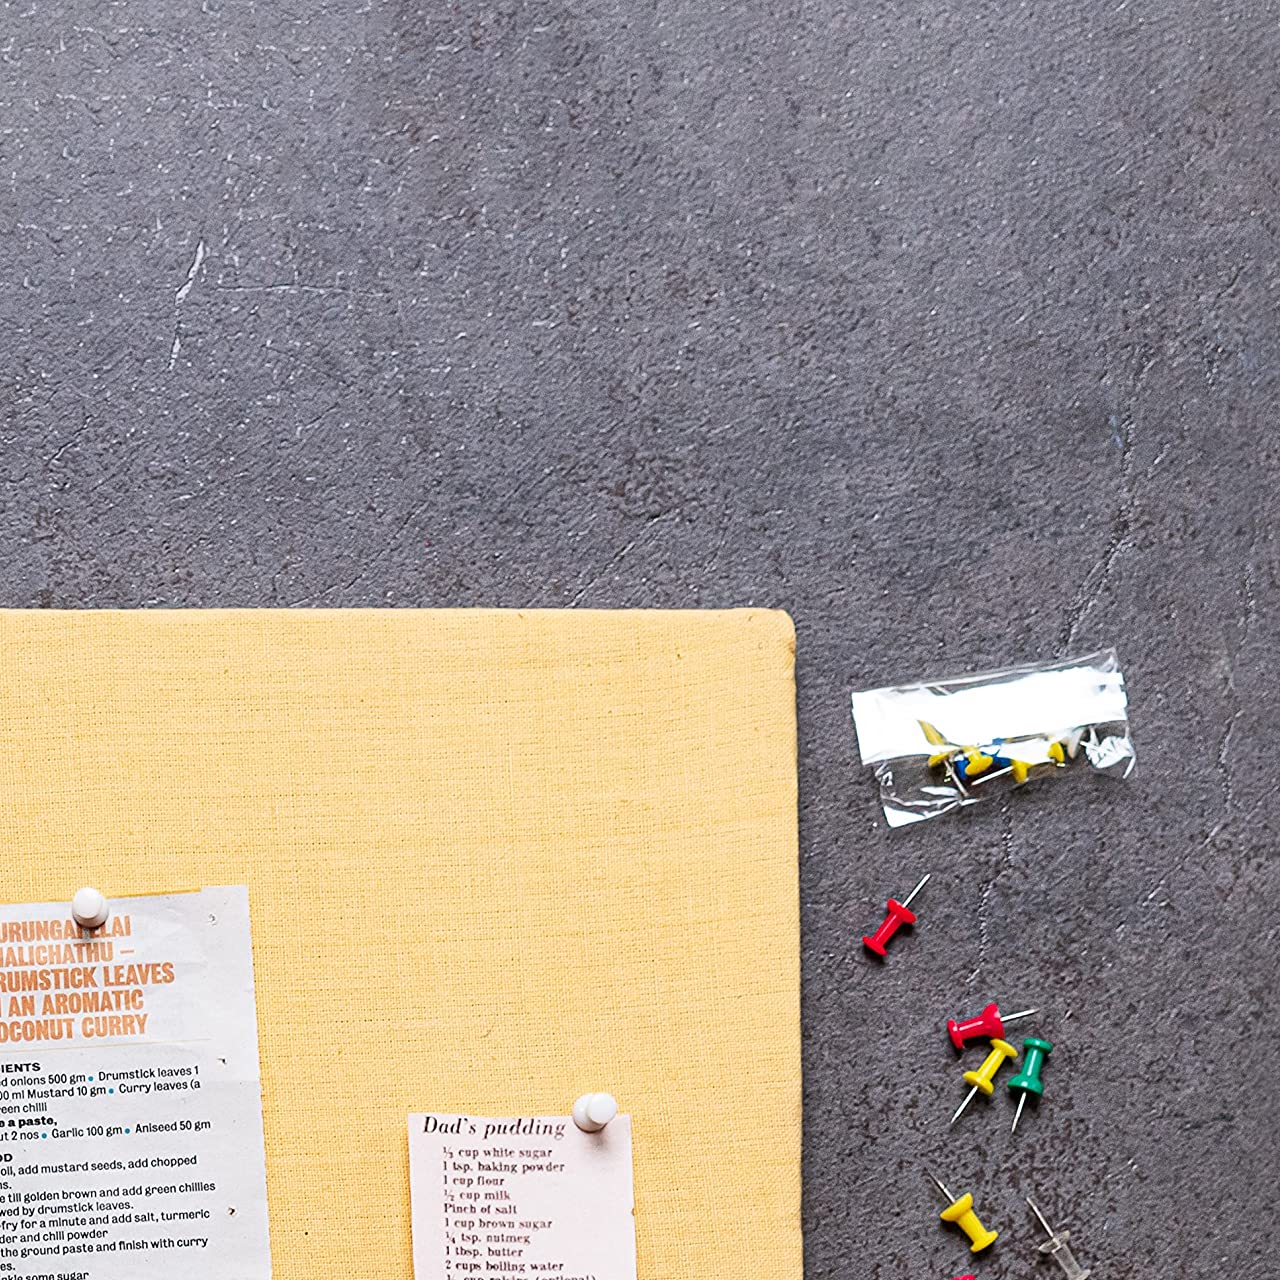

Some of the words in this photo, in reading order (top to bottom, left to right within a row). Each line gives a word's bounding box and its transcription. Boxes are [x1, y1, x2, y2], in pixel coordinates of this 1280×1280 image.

[102, 961, 174, 987] LEAVES
[8, 994, 35, 1017] AN
[41, 988, 143, 1015] AROMATIC
[81, 1013, 148, 1038] CURRY
[10, 1076, 46, 1086] onions
[48, 1073, 67, 1084] 500
[69, 1074, 85, 1085] gm
[98, 1068, 156, 1081] Drumstick
[157, 1067, 192, 1077] leaves
[194, 1065, 198, 1074] 1
[11, 1089, 24, 1099] ml
[27, 1086, 74, 1099] Mustard
[76, 1085, 87, 1096] 10
[89, 1086, 106, 1097] gm
[118, 1083, 151, 1094] Curry
[153, 1081, 188, 1091] leaves
[190, 1078, 200, 1090] (a
[7, 1119, 16, 1127] a
[18, 1116, 57, 1129] paste,
[11, 1130, 18, 1140] 2
[19, 1131, 39, 1140] nos
[51, 1127, 84, 1138] Garlic
[86, 1125, 104, 1136] 100
[105, 1126, 122, 1137] gm
[135, 1121, 177, 1133] Aniseed
[179, 1120, 192, 1131] 50
[194, 1120, 211, 1131] gm
[483, 1118, 565, 1139] pudding
[458, 1149, 479, 1160] cup
[482, 1147, 515, 1157] white
[519, 1149, 552, 1159] sugar
[0, 1165, 16, 1177] oil,
[17, 1164, 38, 1175] add
[40, 1161, 88, 1174] mustard
[90, 1160, 126, 1171] seeds,
[127, 1157, 148, 1169] add
[150, 1154, 197, 1168] chopped
[477, 1161, 517, 1173] baking
[522, 1161, 565, 1174] powder
[452, 1177, 474, 1188] cup
[477, 1175, 504, 1185] flour
[7, 1192, 21, 1203] till
[23, 1191, 59, 1204] golden
[61, 1190, 97, 1199] brown
[99, 1187, 119, 1197] and
[122, 1185, 142, 1196] add
[144, 1185, 176, 1197] green
[178, 1181, 216, 1193] chillies
[459, 1192, 480, 1202] cup
[484, 1190, 510, 1200] milk
[21, 1206, 35, 1217] by
[37, 1202, 94, 1215] drumstick
[95, 1201, 134, 1211] leaves.
[444, 1202, 476, 1214] Pinch
[480, 1204, 490, 1214] of
[495, 1204, 517, 1214] salt
[20, 1219, 37, 1229] for
[39, 1220, 46, 1228] a
[48, 1216, 86, 1227] minute
[88, 1214, 109, 1225] and
[111, 1213, 132, 1224] add
[134, 1212, 158, 1222] salt,
[160, 1208, 210, 1221] turmeric
[478, 1218, 515, 1228] brown
[19, 1232, 40, 1242] and
[67, 1228, 108, 1242] powder
[0, 1247, 18, 1258] the
[20, 1244, 60, 1258] ground
[62, 1243, 93, 1255] paste
[95, 1241, 116, 1252] and
[118, 1239, 148, 1250] finish
[150, 1238, 174, 1248] with
[176, 1238, 208, 1248] curry
[487, 1246, 523, 1256] butter
[455, 1262, 481, 1273] cups
[485, 1260, 525, 1273] boiling
[530, 1262, 564, 1271] water
